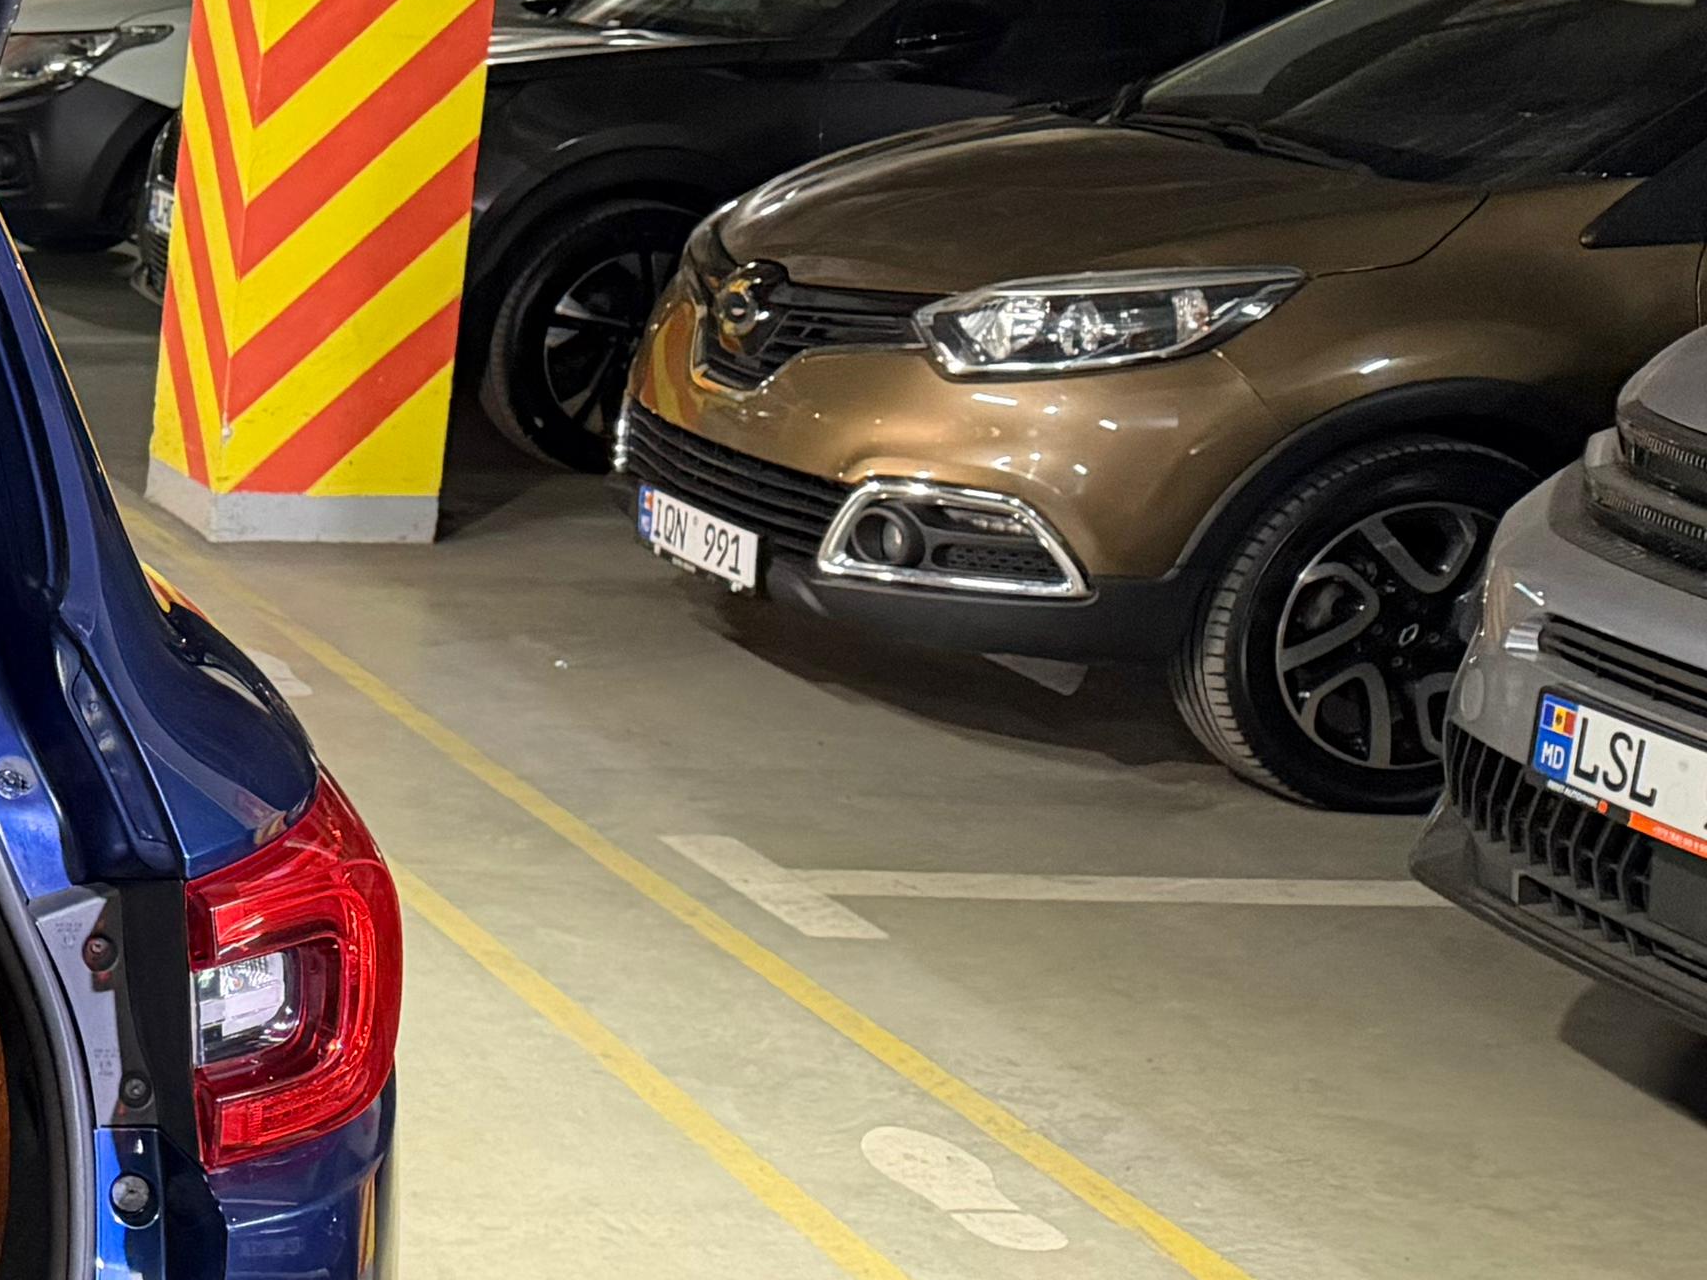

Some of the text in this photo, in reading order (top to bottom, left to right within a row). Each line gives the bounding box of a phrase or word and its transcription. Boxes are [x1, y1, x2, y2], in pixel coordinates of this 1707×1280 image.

[703, 523, 742, 576] 991
[1540, 740, 1566, 771] MD
[1573, 716, 1658, 808] LSL
